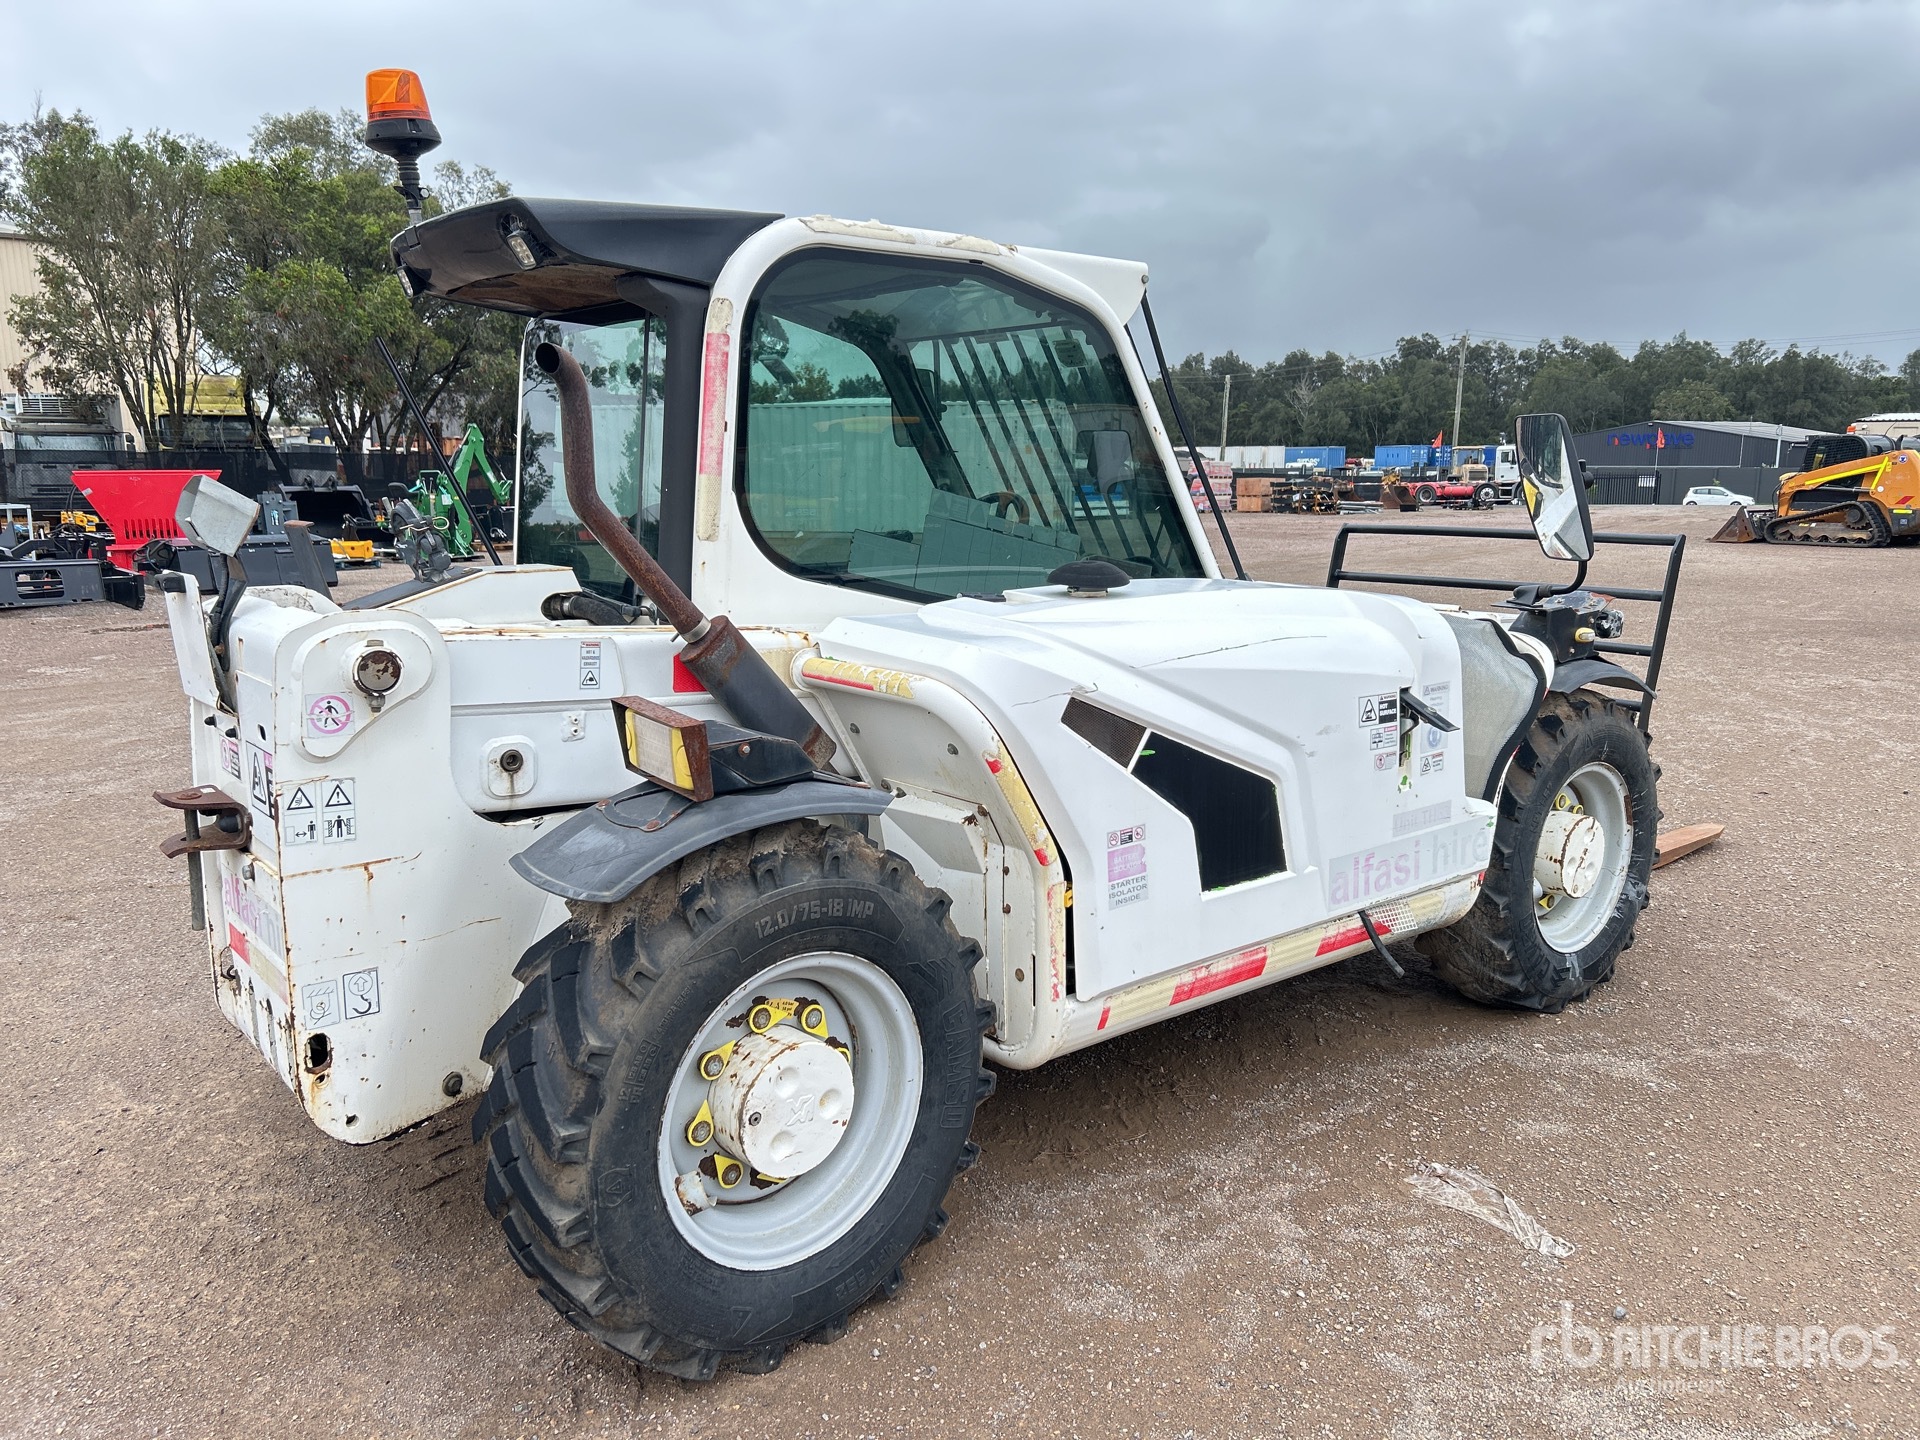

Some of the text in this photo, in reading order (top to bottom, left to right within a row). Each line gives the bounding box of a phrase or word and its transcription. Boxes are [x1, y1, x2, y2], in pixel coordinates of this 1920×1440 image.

[1331, 828, 1488, 905] alfasi hire
[1108, 883, 1148, 899] ISOLATOR
[1110, 875, 1146, 890] STARTER
[1116, 893, 1141, 905] INSIDE
[755, 898, 875, 939] 12.0/75-18 IMP
[940, 1000, 973, 1129] CAMSO
